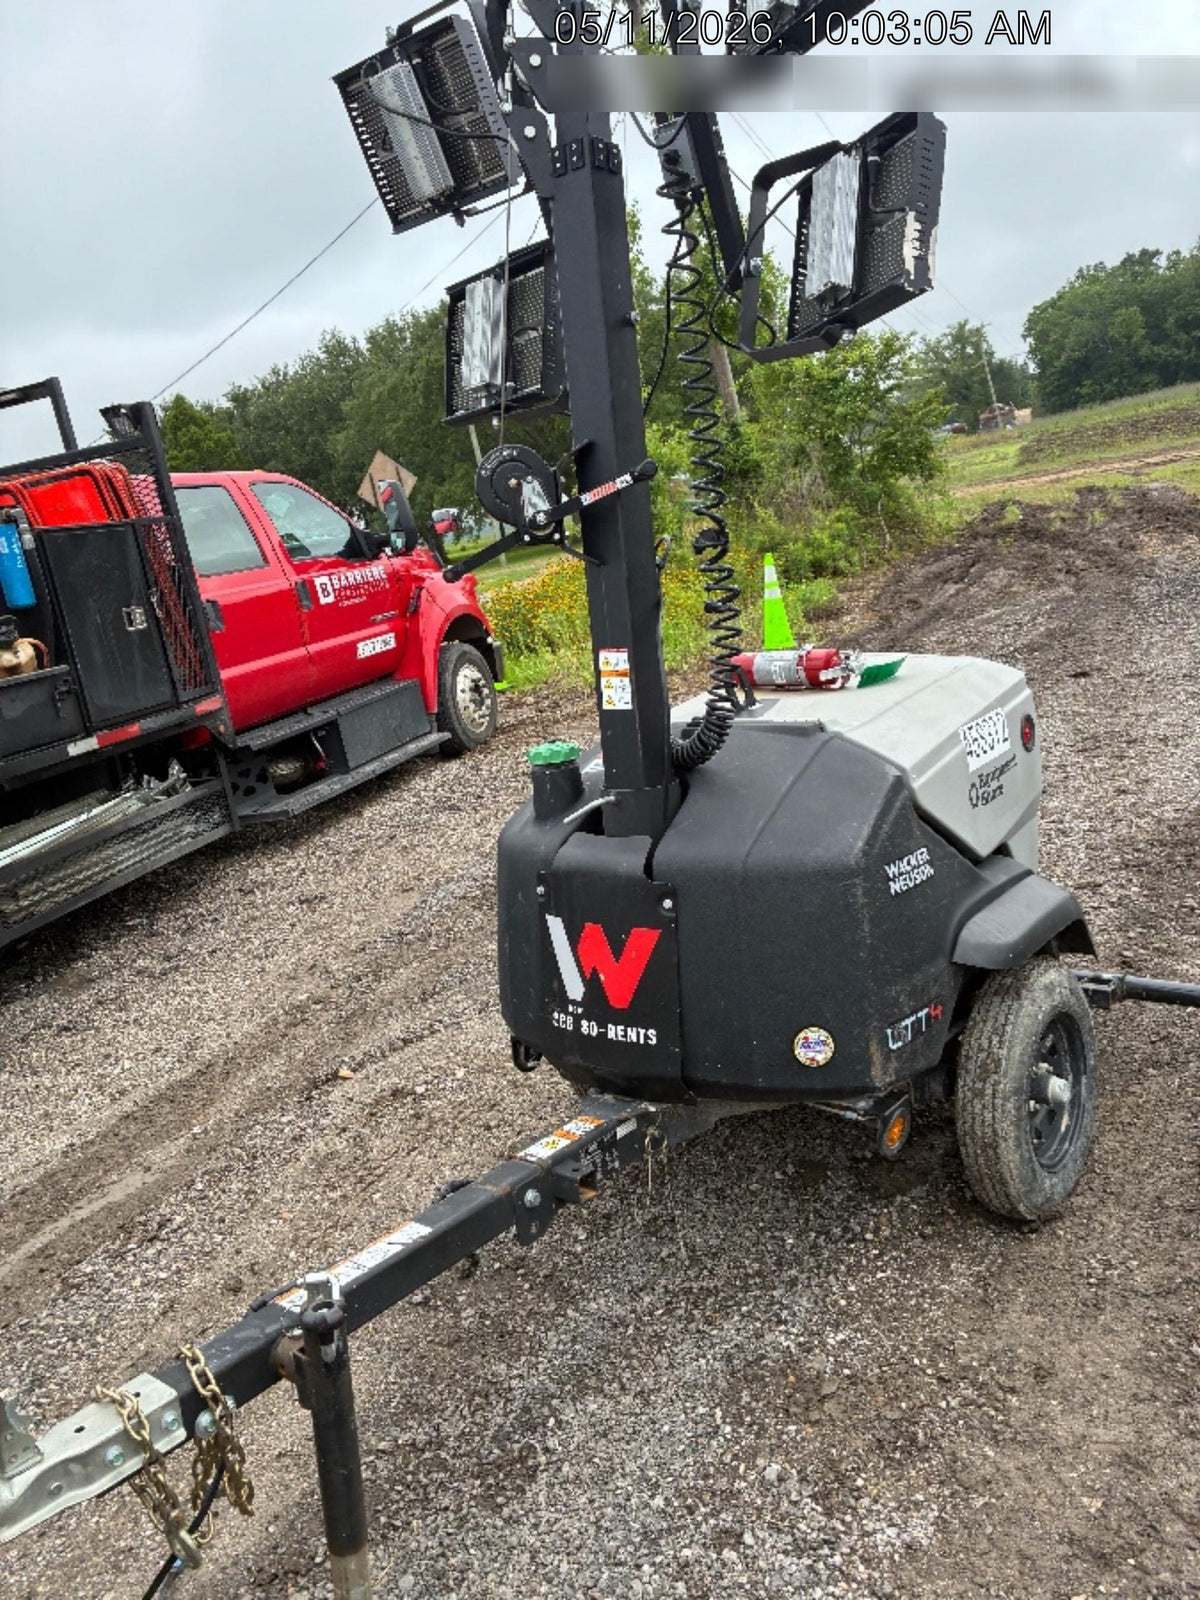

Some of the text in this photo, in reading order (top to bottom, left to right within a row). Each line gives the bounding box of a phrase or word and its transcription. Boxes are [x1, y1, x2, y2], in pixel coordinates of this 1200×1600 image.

[331, 565, 387, 589] BARRIERE
[884, 847, 931, 879] WACKER
[888, 863, 934, 897] NEUSON
